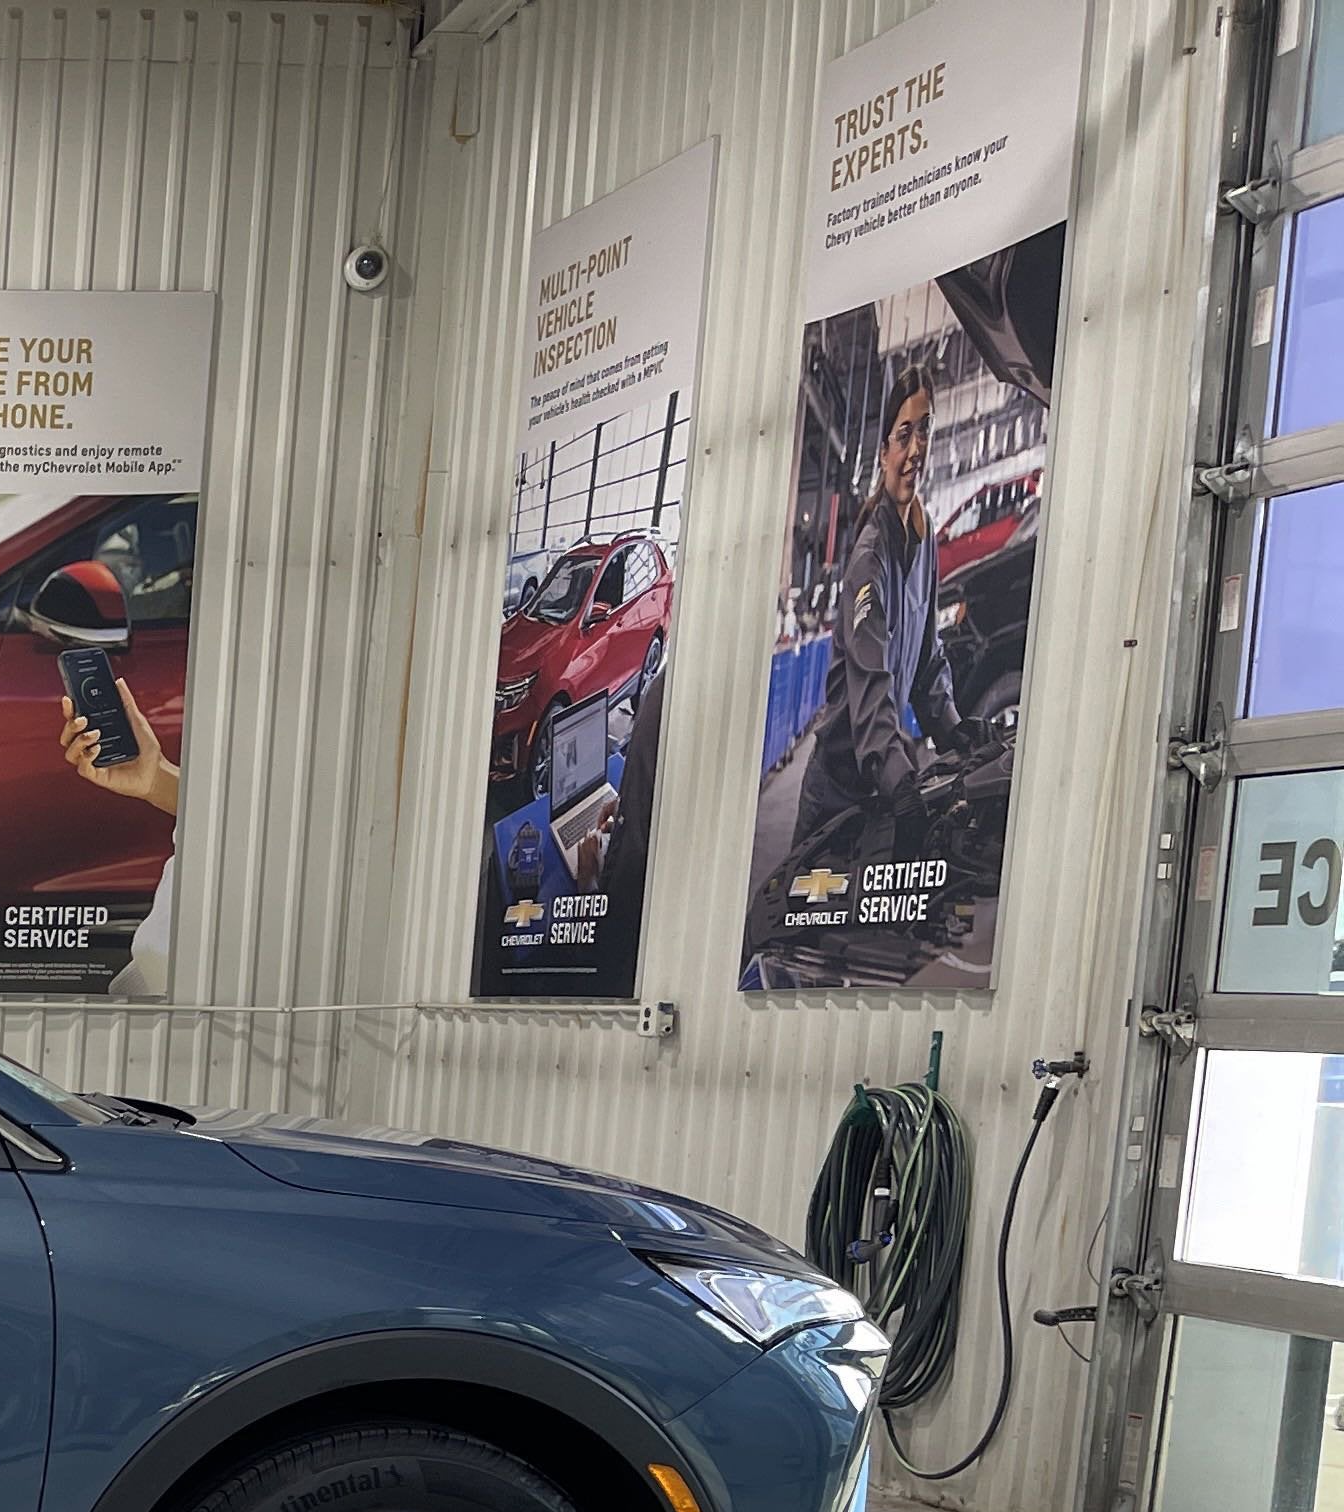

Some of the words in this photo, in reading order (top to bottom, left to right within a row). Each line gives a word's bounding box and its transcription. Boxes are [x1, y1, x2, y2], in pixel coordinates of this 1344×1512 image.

[834, 86, 898, 148] TRUST
[904, 62, 946, 113] THE
[830, 119, 928, 193] EXPERTS.
[827, 203, 861, 228] Factory
[862, 184, 896, 213] trained
[898, 163, 952, 198] technicians
[954, 147, 982, 172] know
[983, 135, 1008, 164] your
[825, 226, 852, 250] Chevy
[854, 214, 885, 237] vehicle
[888, 200, 917, 227] better
[919, 190, 941, 212] than
[943, 172, 982, 200] anyone.
[539, 234, 633, 306] MULTI-POINT
[537, 290, 595, 342] VEHICLE
[19, 337, 93, 364] YOUR
[533, 316, 617, 378] INSPECTION
[16, 370, 93, 397] FROM
[530, 395, 541, 408] The
[542, 388, 560, 407] peace
[562, 381, 569, 396] of
[570, 374, 585, 392] mind
[586, 370, 600, 385] that
[601, 361, 623, 379] comes
[624, 354, 641, 369] from
[642, 341, 669, 364] getting
[55, 444, 78, 457] and
[81, 445, 114, 460] enjoy
[117, 445, 163, 457] remote
[0, 460, 20, 473] the
[23, 460, 102, 476] myChevrolet
[105, 461, 145, 474] Mobile
[863, 860, 948, 892] CERTIFIED
[4, 906, 108, 926] CERTIFIED
[552, 894, 608, 919] CERTIFIED
[785, 911, 849, 926] CHEVROLET
[859, 894, 930, 924] SERVICE
[3, 929, 89, 948] SERVICE
[501, 933, 544, 947] CHEVROLET
[550, 922, 596, 944] SERVICE
